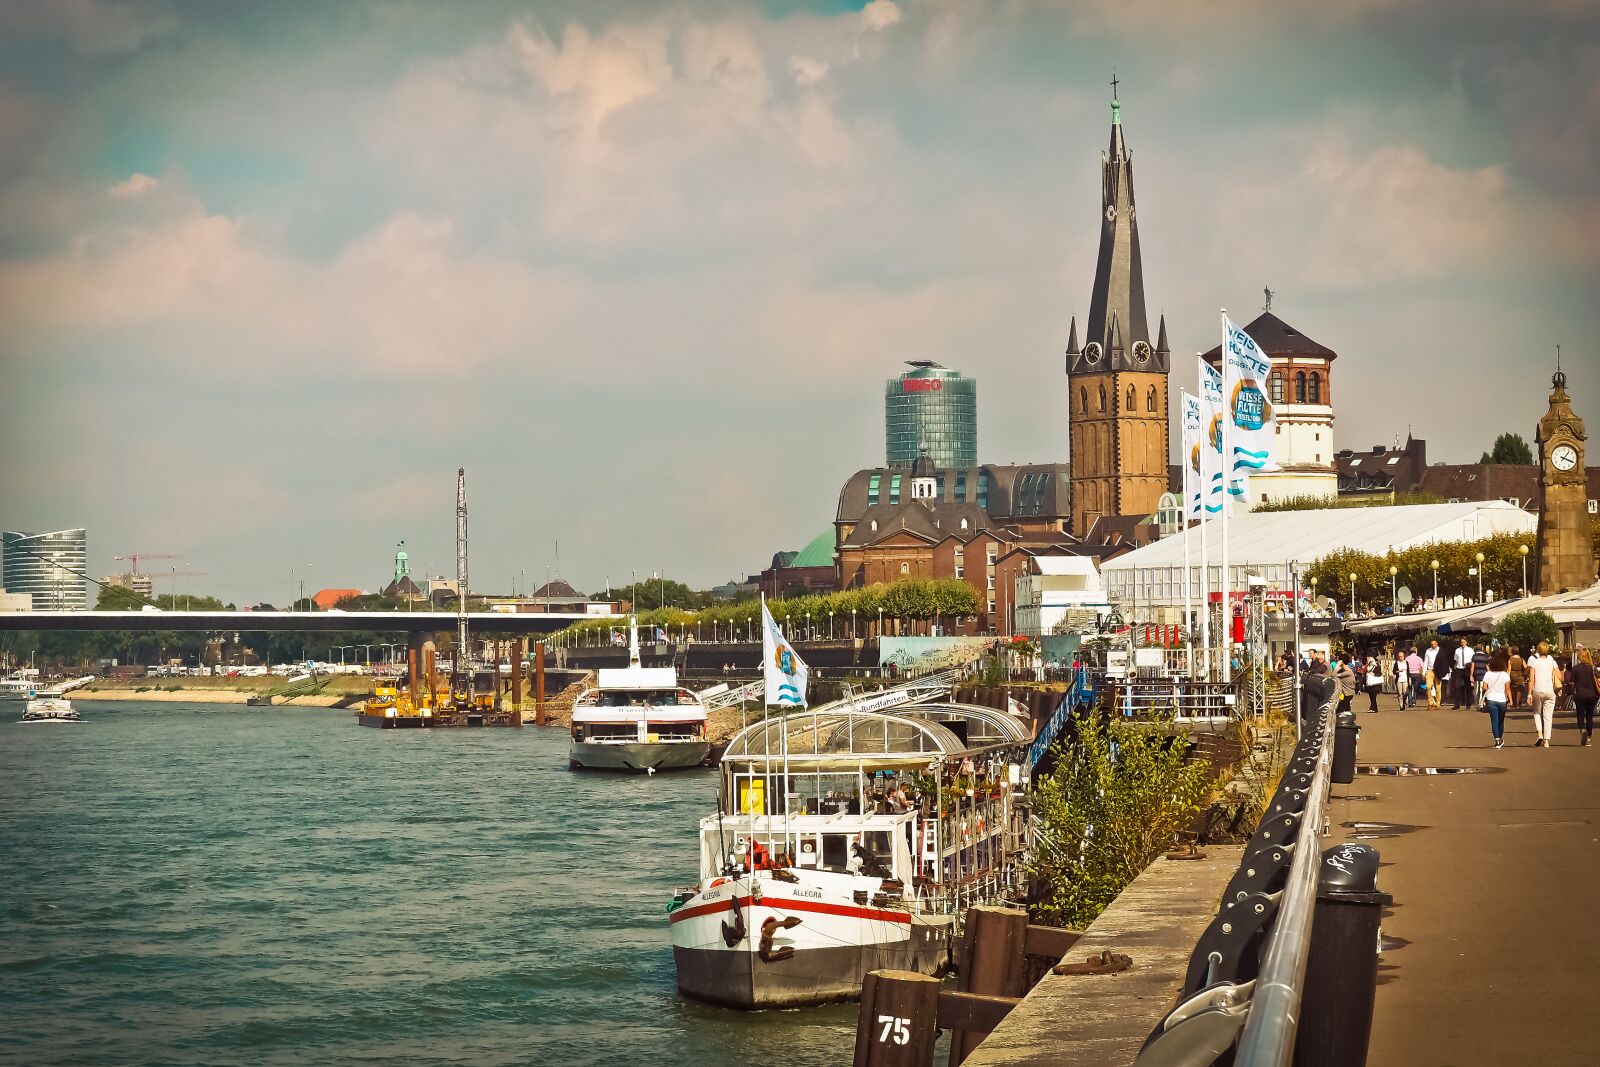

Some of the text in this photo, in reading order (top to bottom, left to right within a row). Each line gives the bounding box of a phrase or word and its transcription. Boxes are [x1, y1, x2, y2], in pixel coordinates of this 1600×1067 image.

[702, 890, 721, 901] ALLEGRA
[793, 888, 822, 899] ALLEGRA
[878, 1015, 911, 1045] 75
